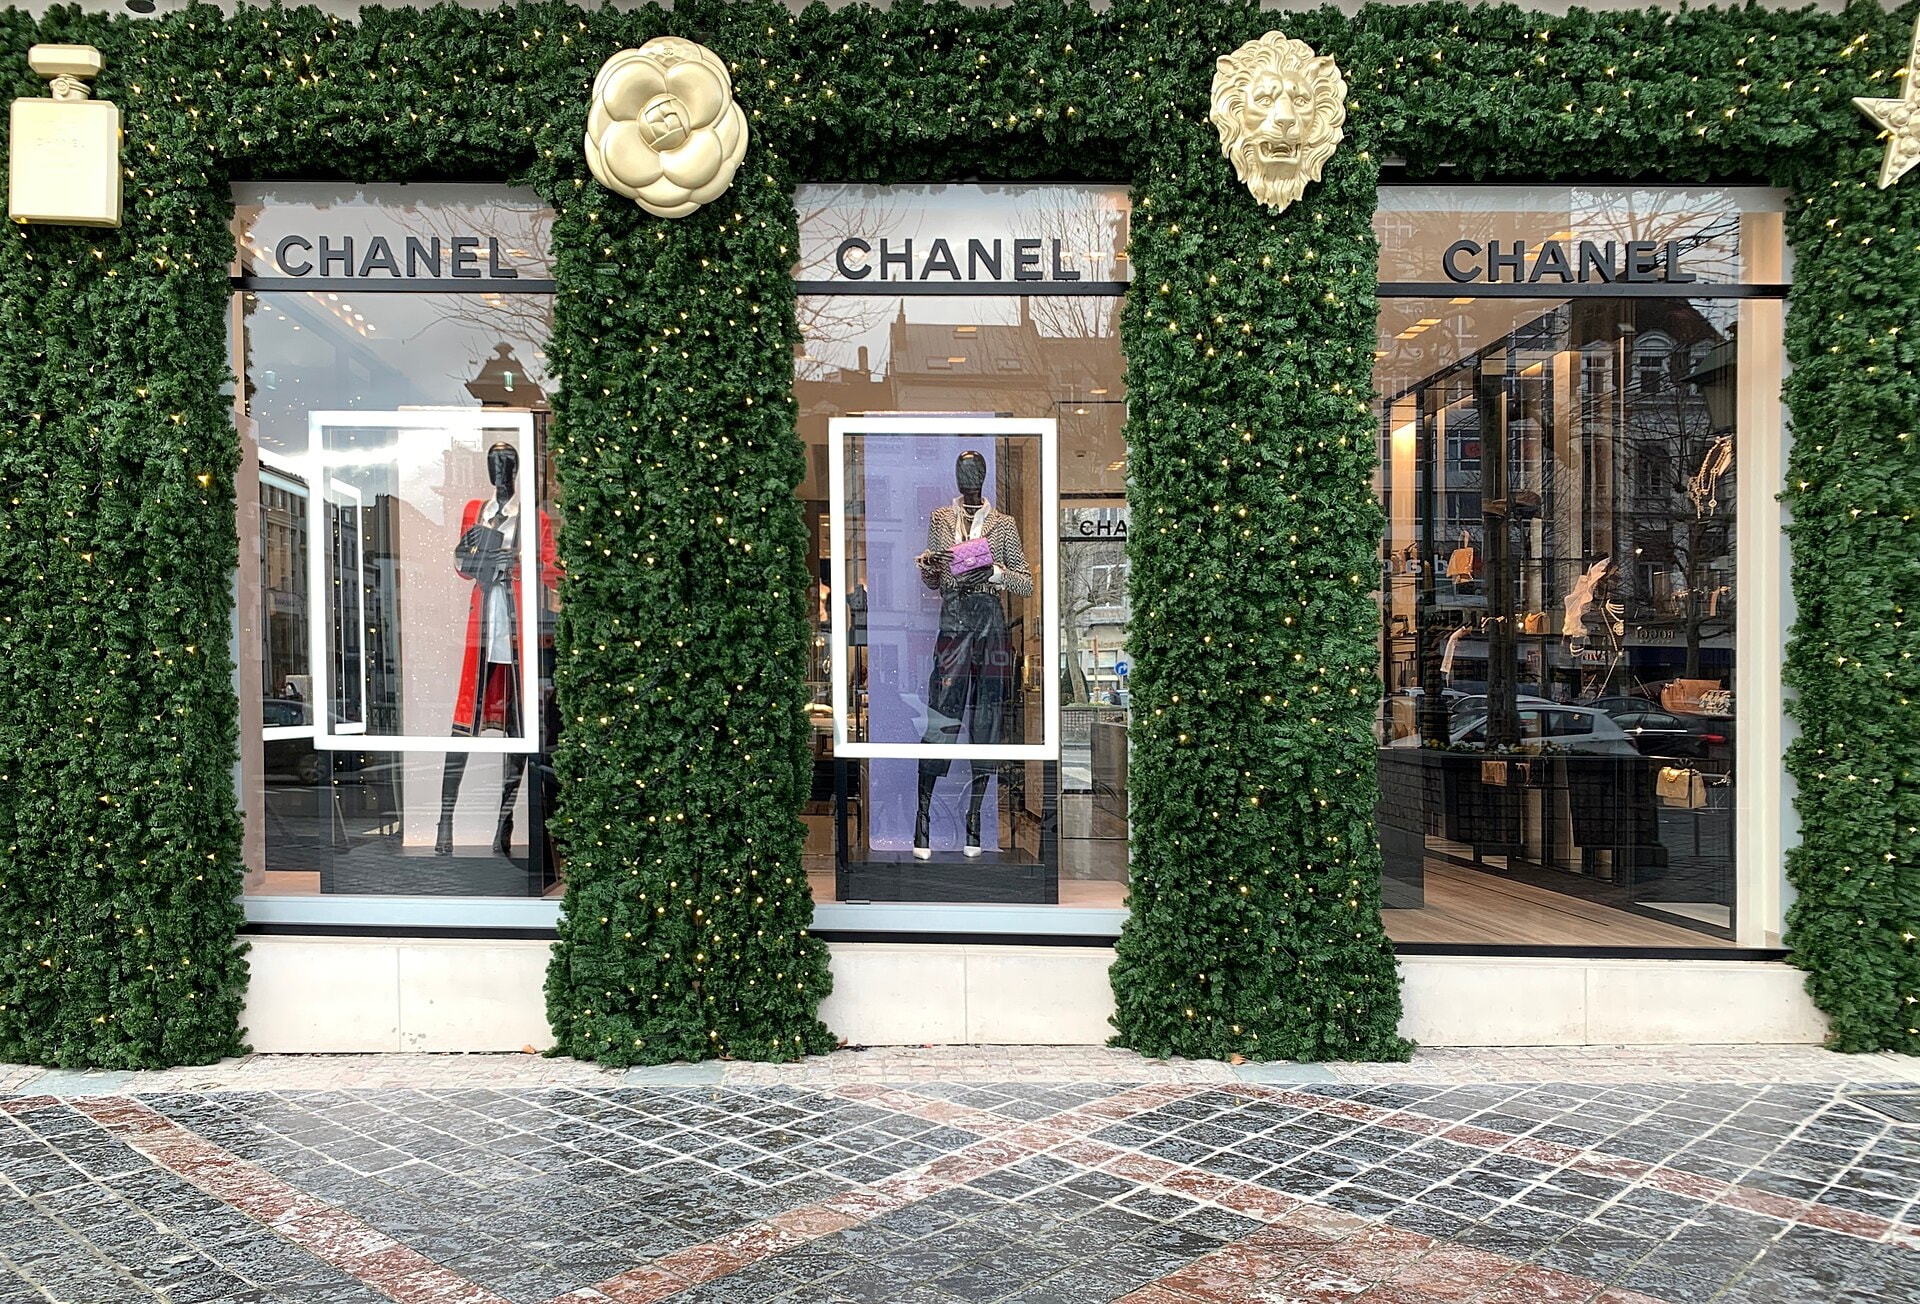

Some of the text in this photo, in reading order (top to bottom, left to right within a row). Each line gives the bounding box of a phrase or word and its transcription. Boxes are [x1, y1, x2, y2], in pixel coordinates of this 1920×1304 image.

[275, 234, 518, 278] CHANEL
[836, 239, 1080, 280] CHANEL
[1443, 239, 1697, 283] CHANEL
